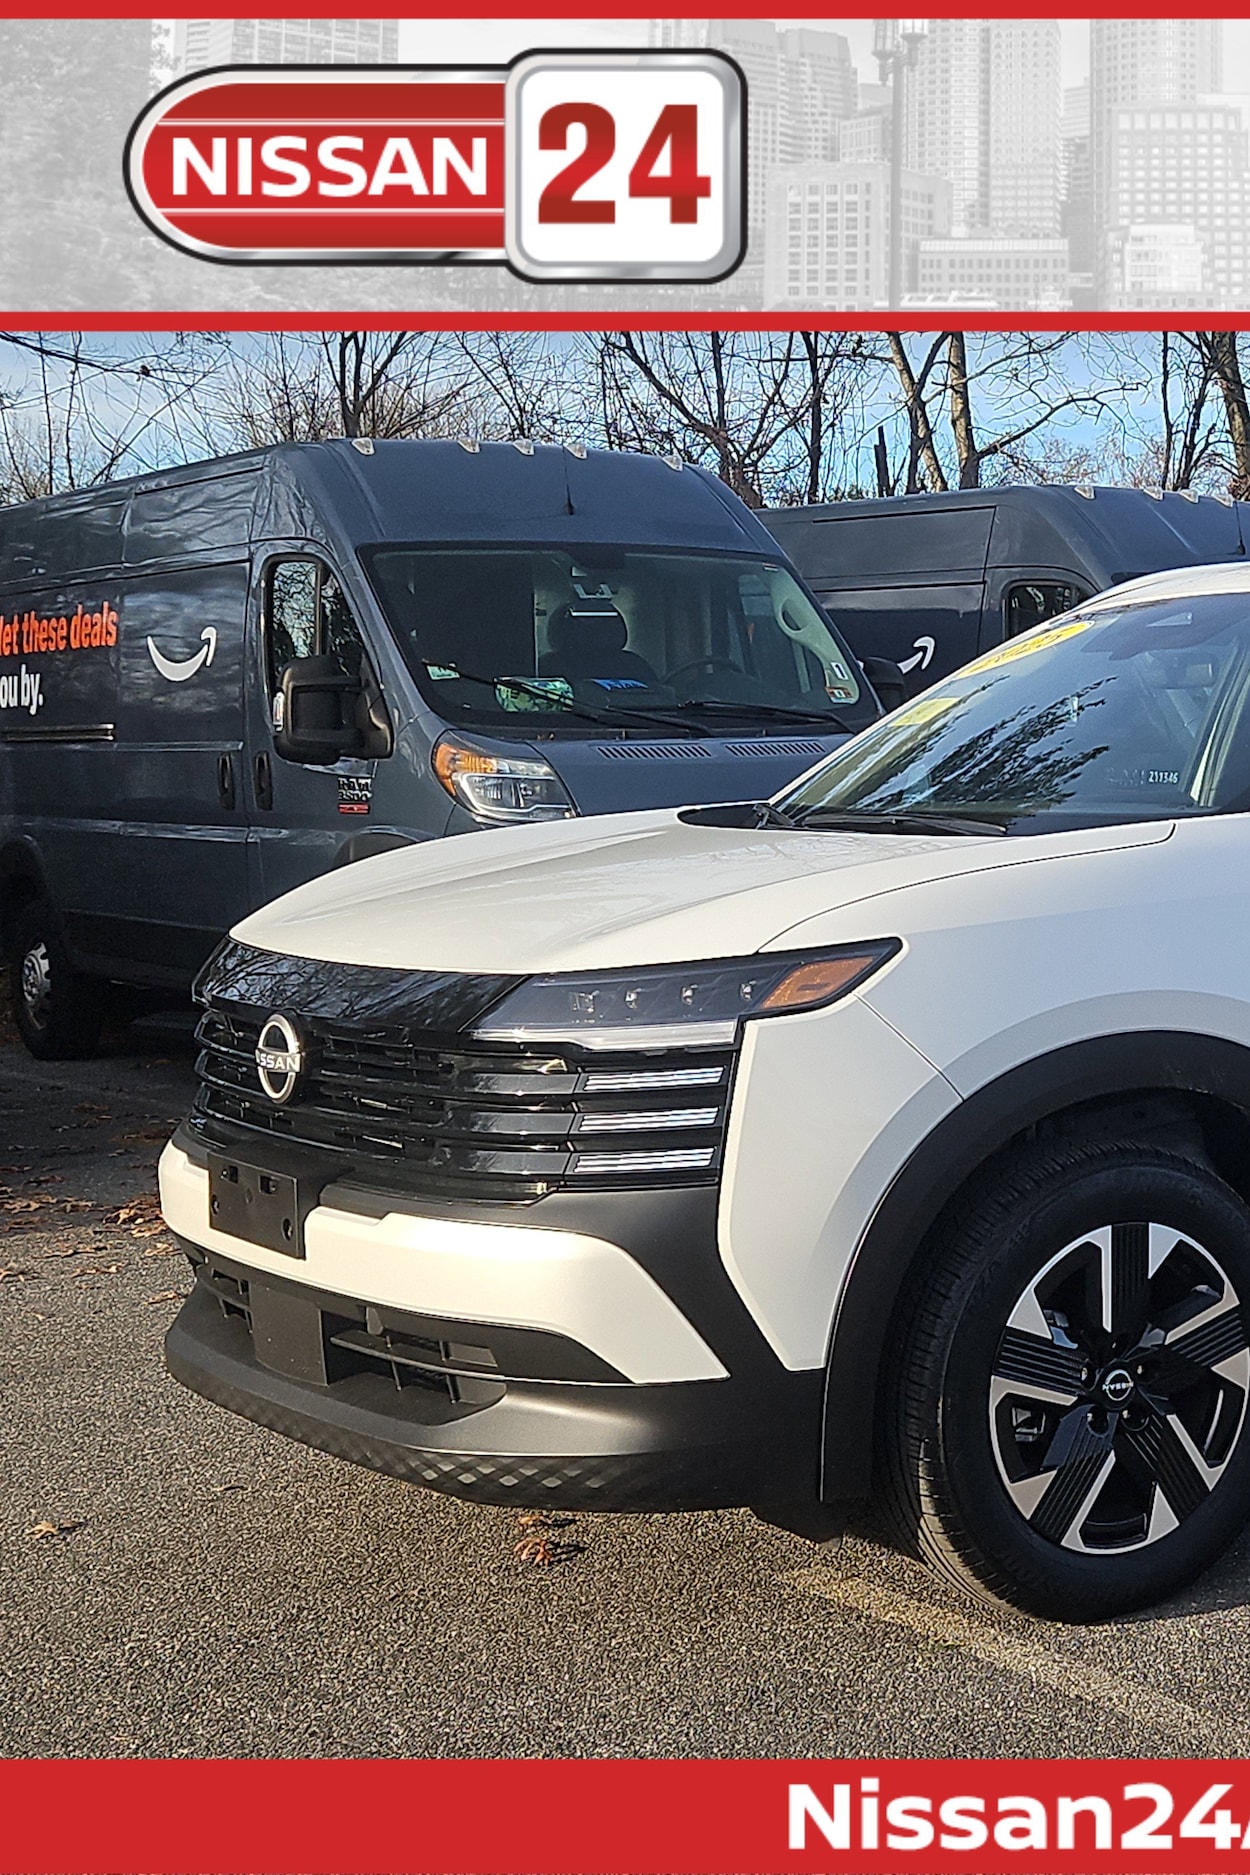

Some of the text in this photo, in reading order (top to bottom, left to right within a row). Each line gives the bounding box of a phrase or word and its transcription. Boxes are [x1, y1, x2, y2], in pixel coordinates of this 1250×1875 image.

[22, 610, 68, 653] these
[70, 601, 118, 648] deals
[20, 663, 44, 716] by.
